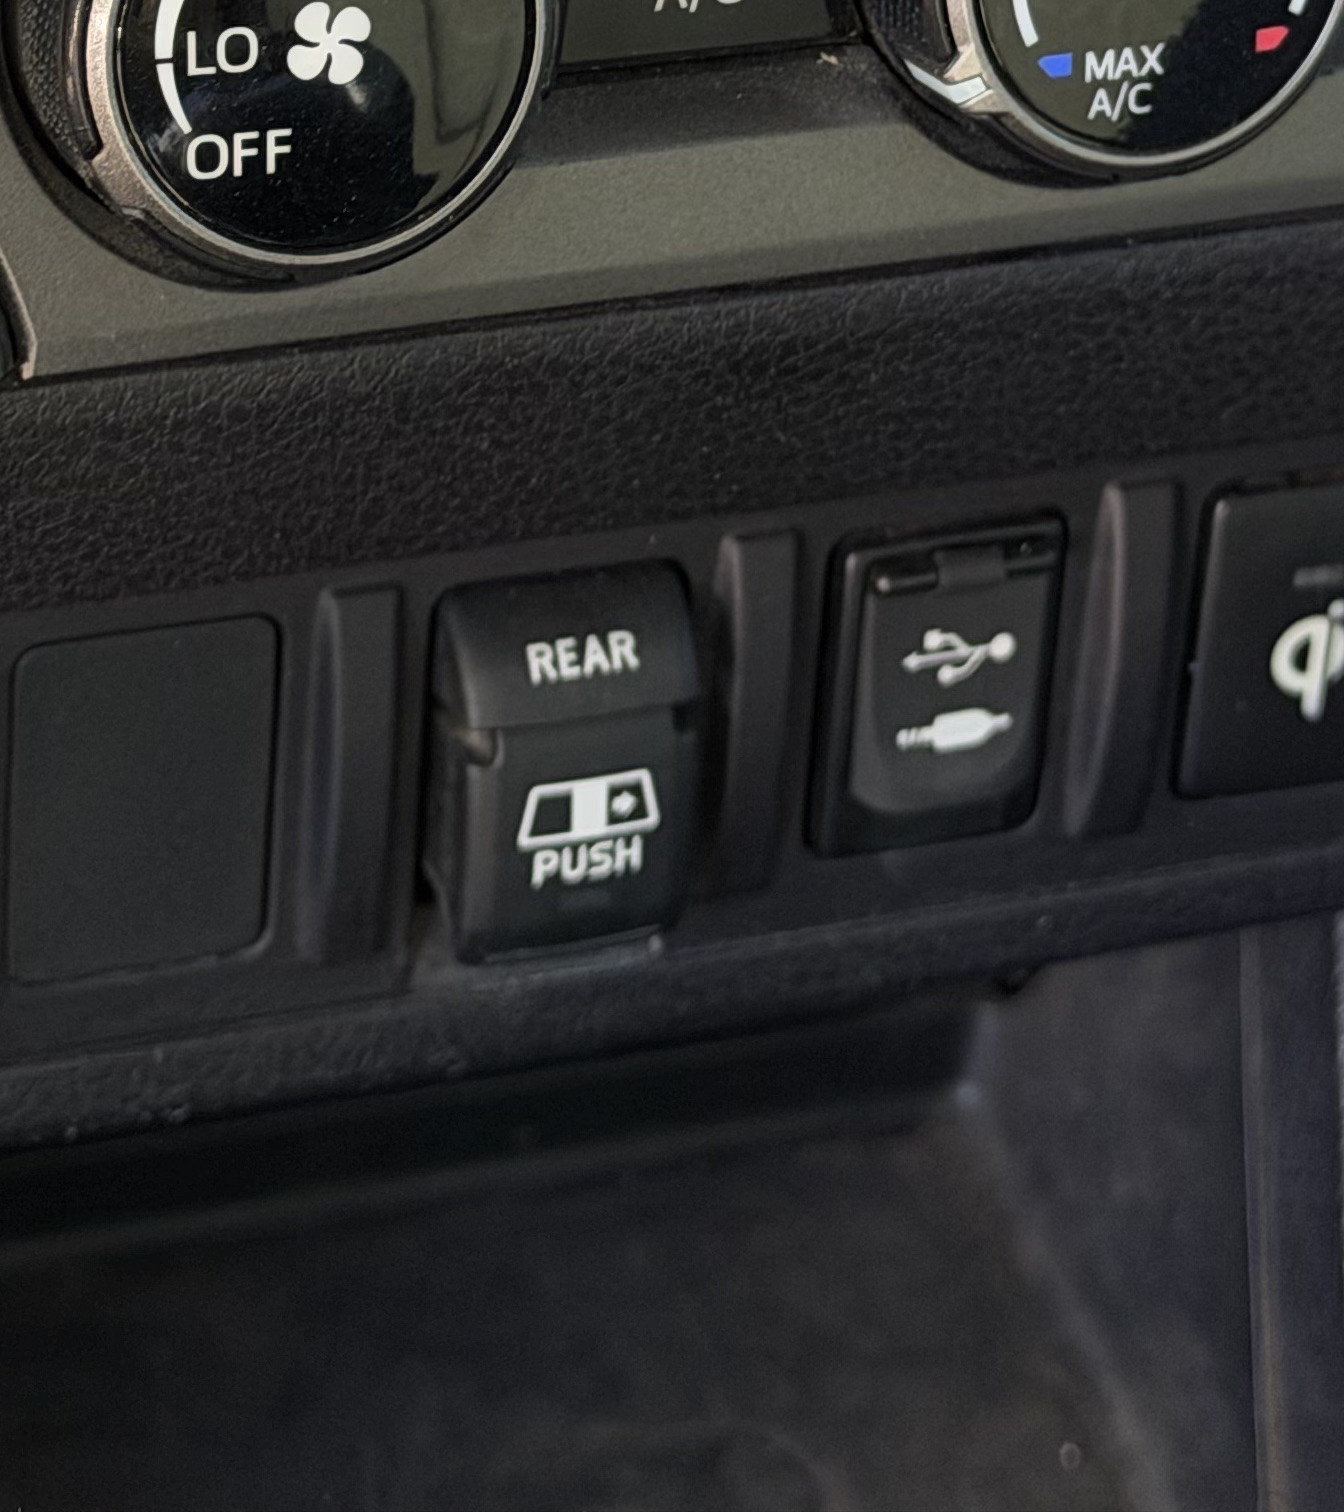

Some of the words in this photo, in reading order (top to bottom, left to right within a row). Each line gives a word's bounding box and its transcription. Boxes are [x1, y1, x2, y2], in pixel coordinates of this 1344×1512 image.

[186, 25, 259, 77] LO
[1084, 43, 1165, 83] MAX
[1087, 82, 1153, 122] A/C
[185, 128, 293, 181] OFF
[525, 629, 640, 685] REAR
[530, 834, 644, 889] PUSH
